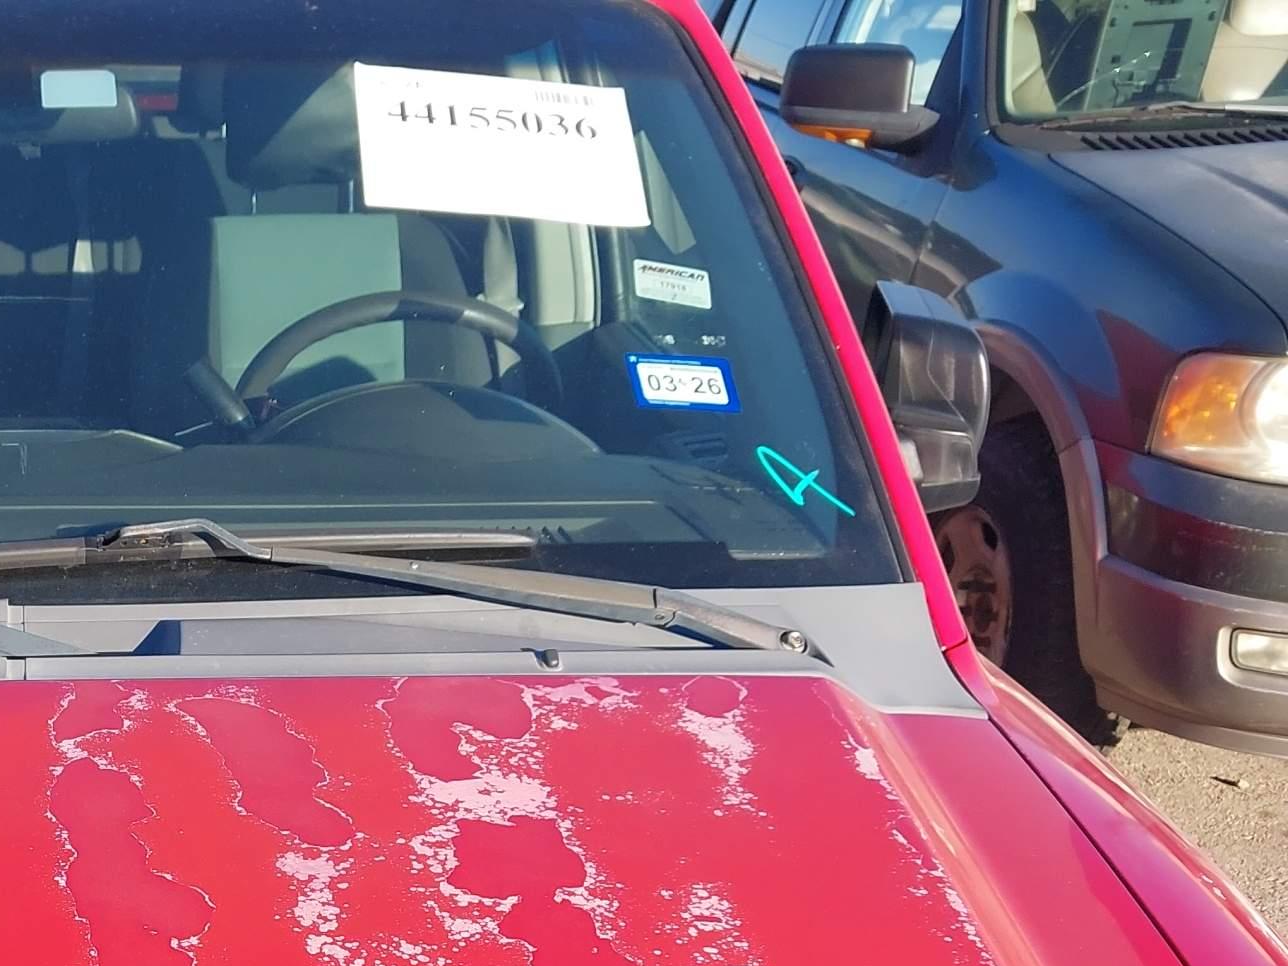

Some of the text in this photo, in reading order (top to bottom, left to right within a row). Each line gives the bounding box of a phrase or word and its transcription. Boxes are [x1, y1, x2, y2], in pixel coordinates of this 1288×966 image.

[387, 100, 598, 139] 44155036
[639, 264, 706, 281] AMERICAN
[647, 374, 722, 395] 03 26
